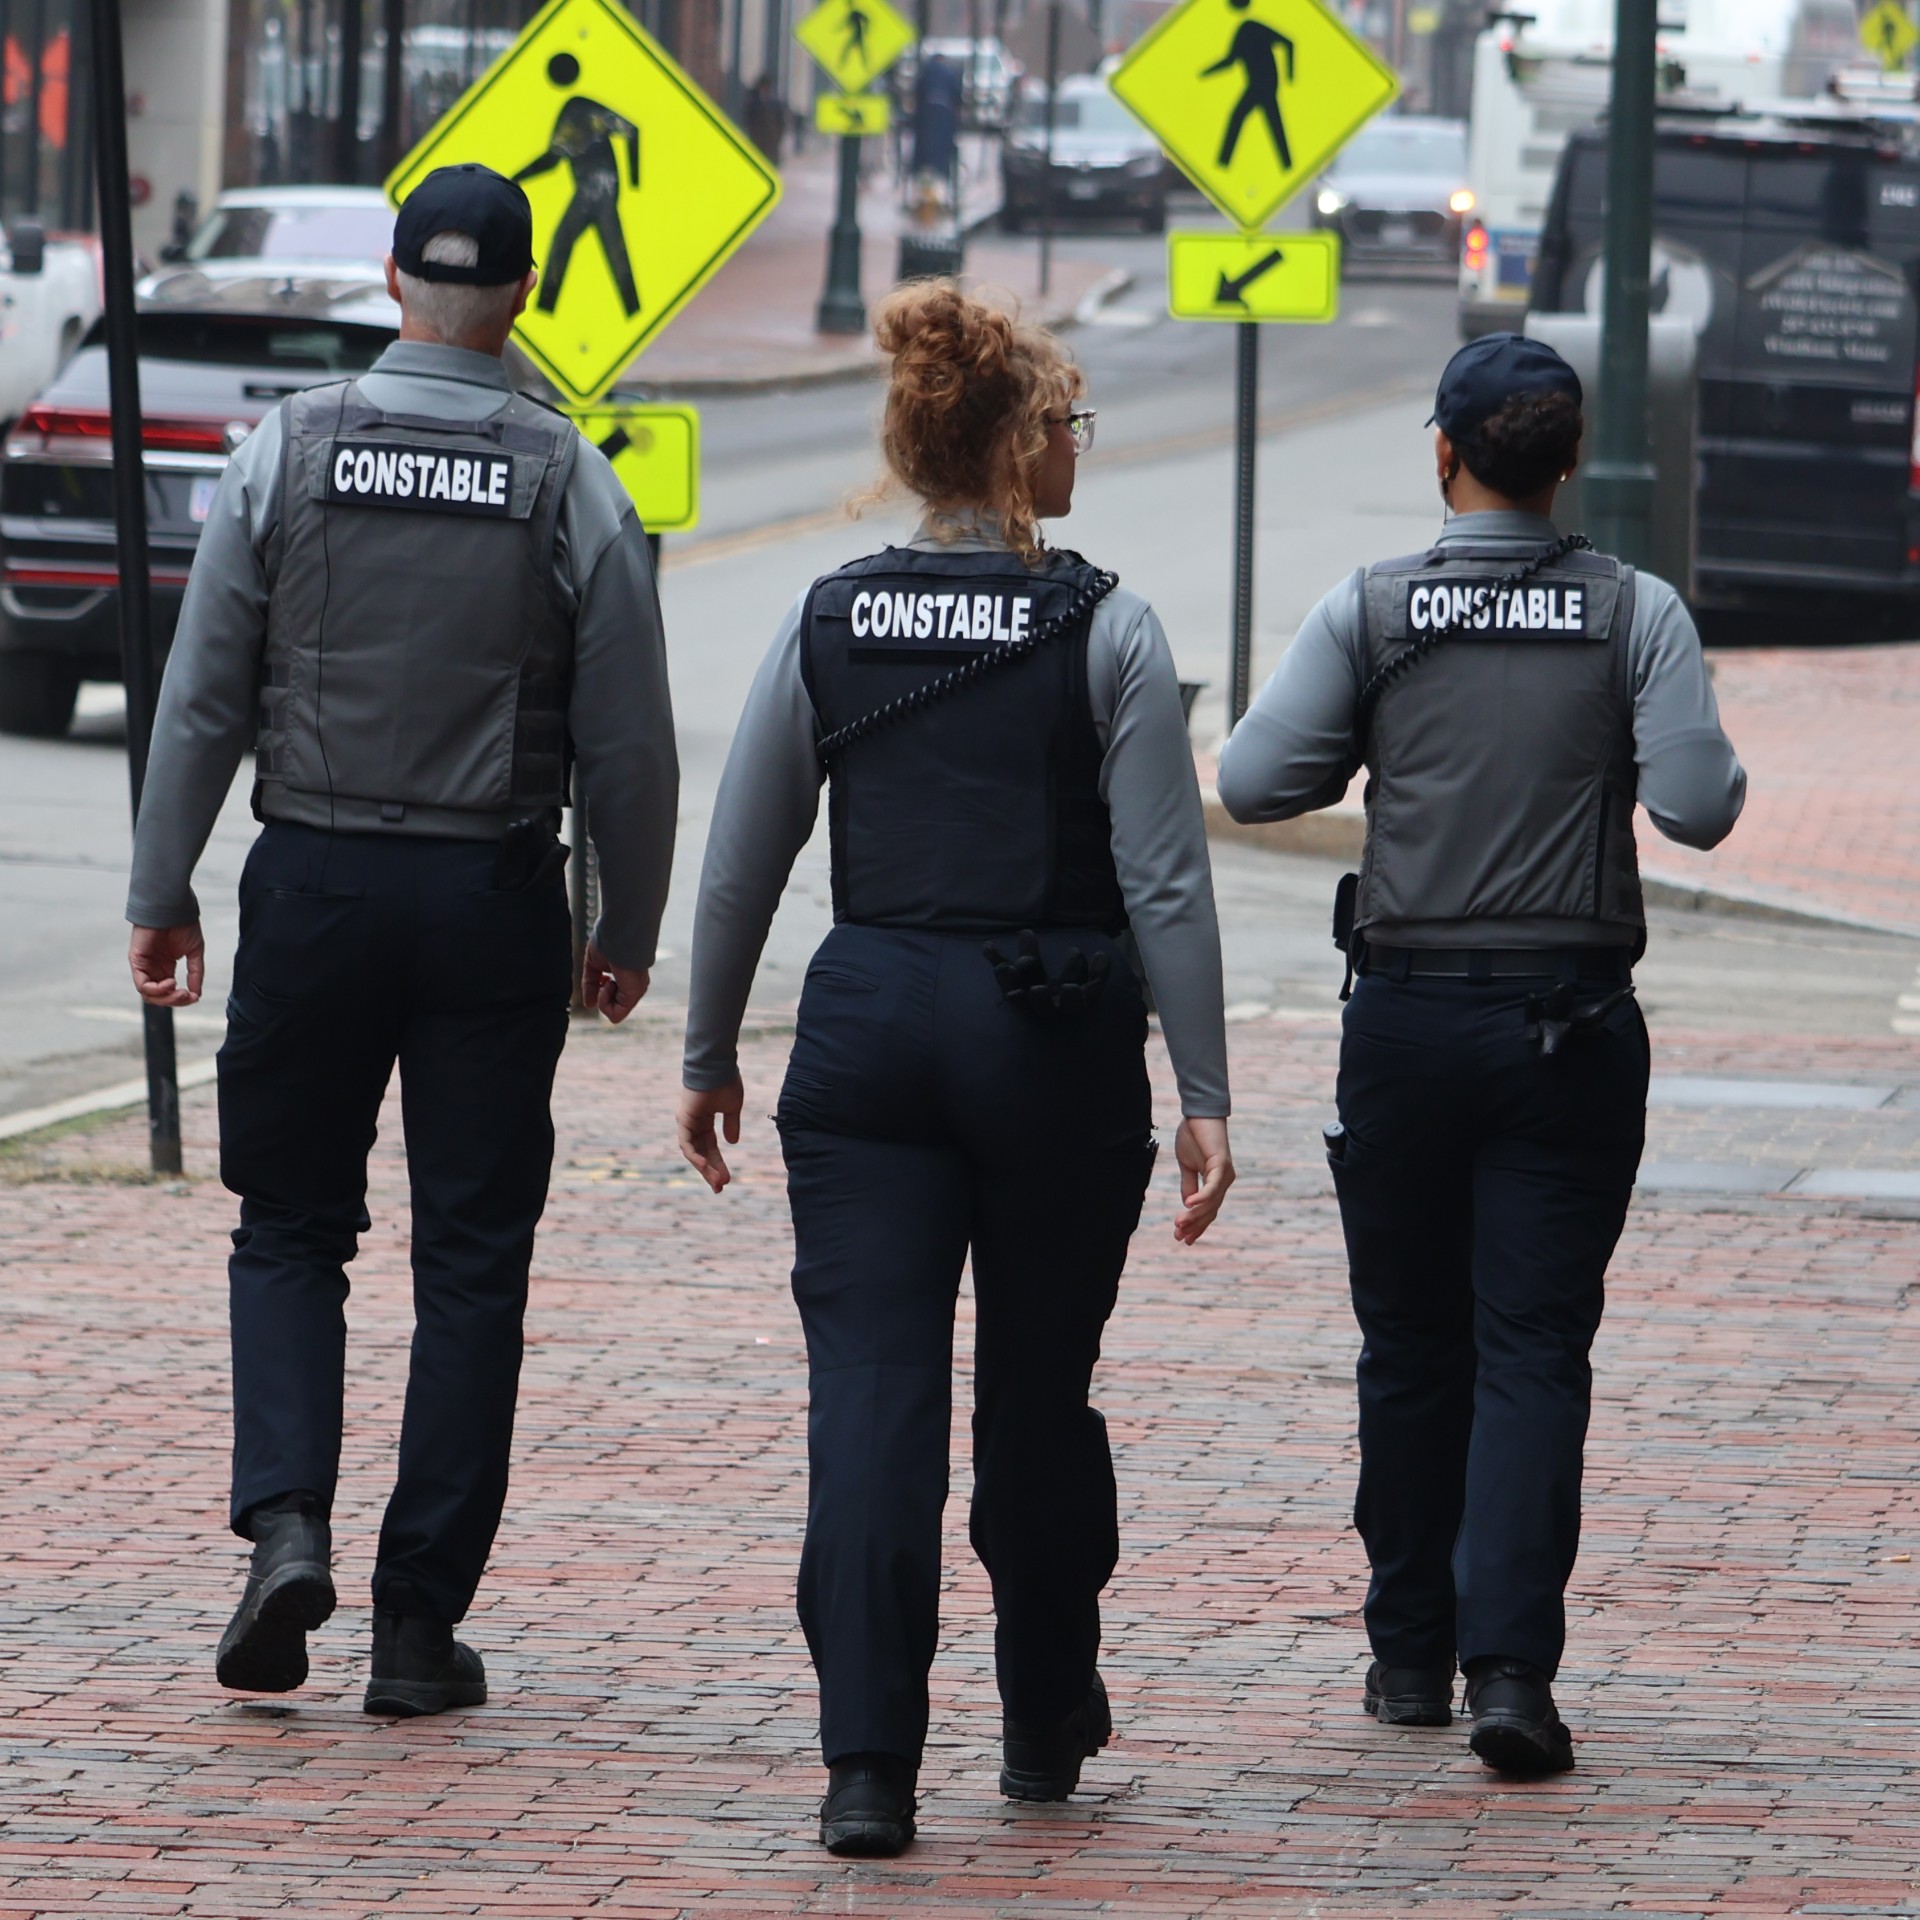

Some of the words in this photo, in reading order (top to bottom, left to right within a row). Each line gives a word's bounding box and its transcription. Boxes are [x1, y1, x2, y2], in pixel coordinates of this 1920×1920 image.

[334, 448, 508, 505] CONSTABLE
[851, 590, 1031, 642] CONSTABLE
[1410, 586, 1582, 630] CONSTABLE
